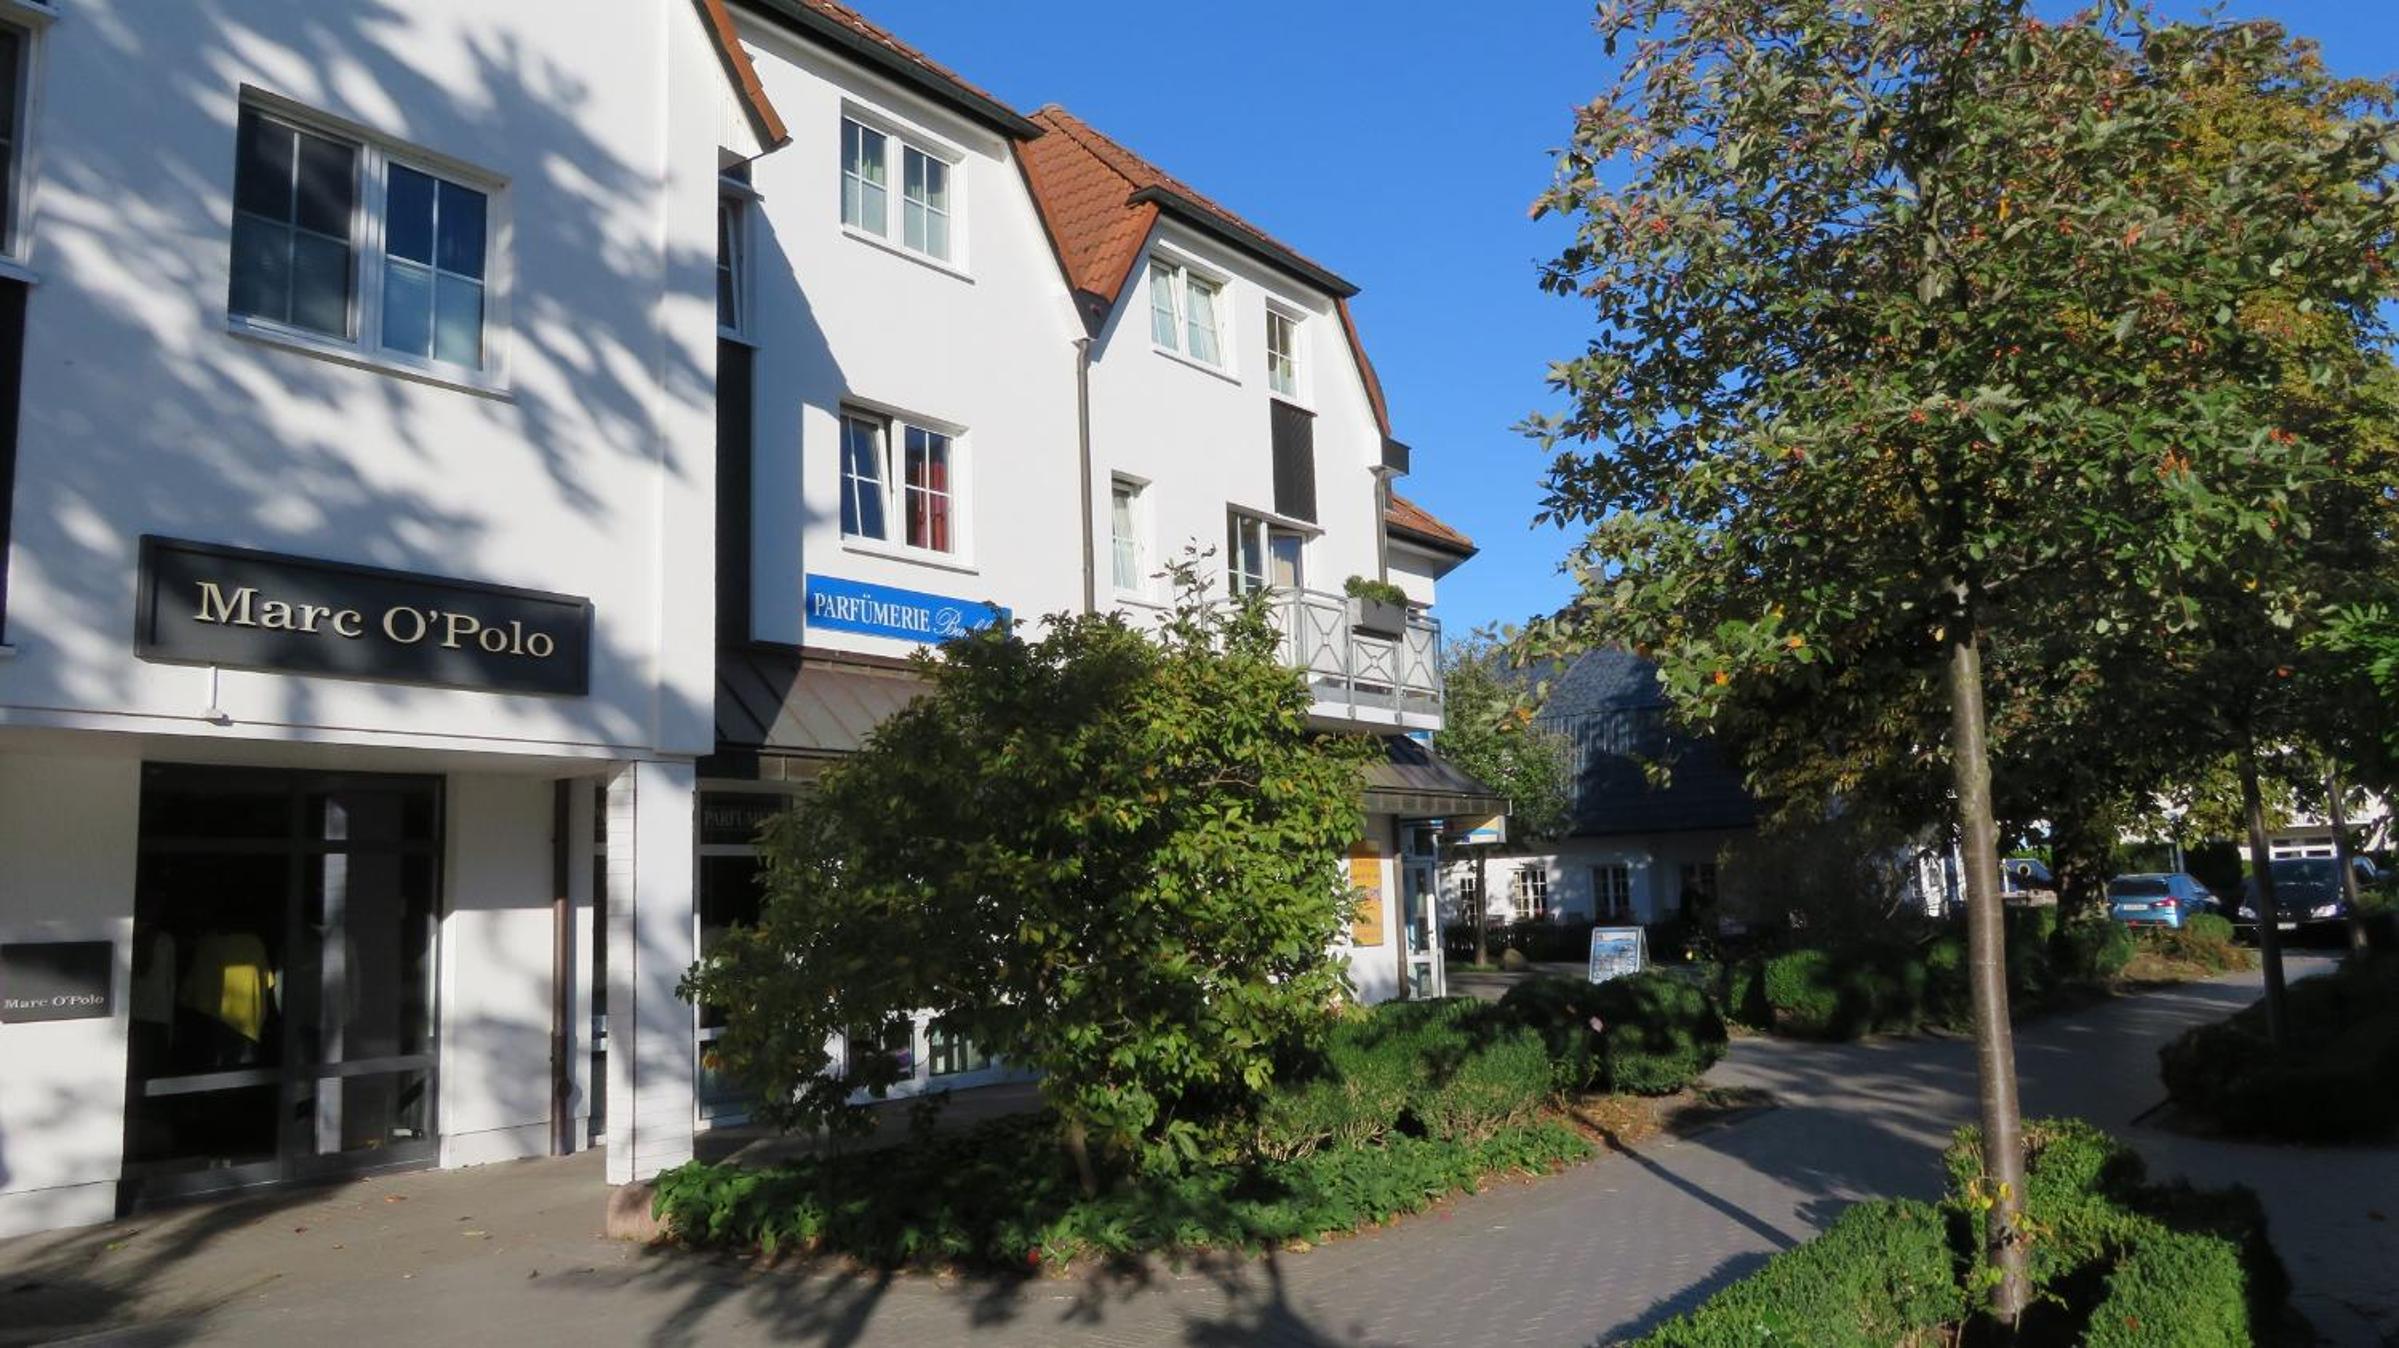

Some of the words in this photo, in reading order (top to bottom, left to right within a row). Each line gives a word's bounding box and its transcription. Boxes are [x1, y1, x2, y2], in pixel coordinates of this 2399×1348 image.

[194, 581, 363, 637] Marc
[382, 606, 555, 659] O'Polo
[813, 592, 931, 633] PARFÜMERIE
[4, 998, 49, 1009] Marc
[52, 994, 105, 1008] O'Polo
